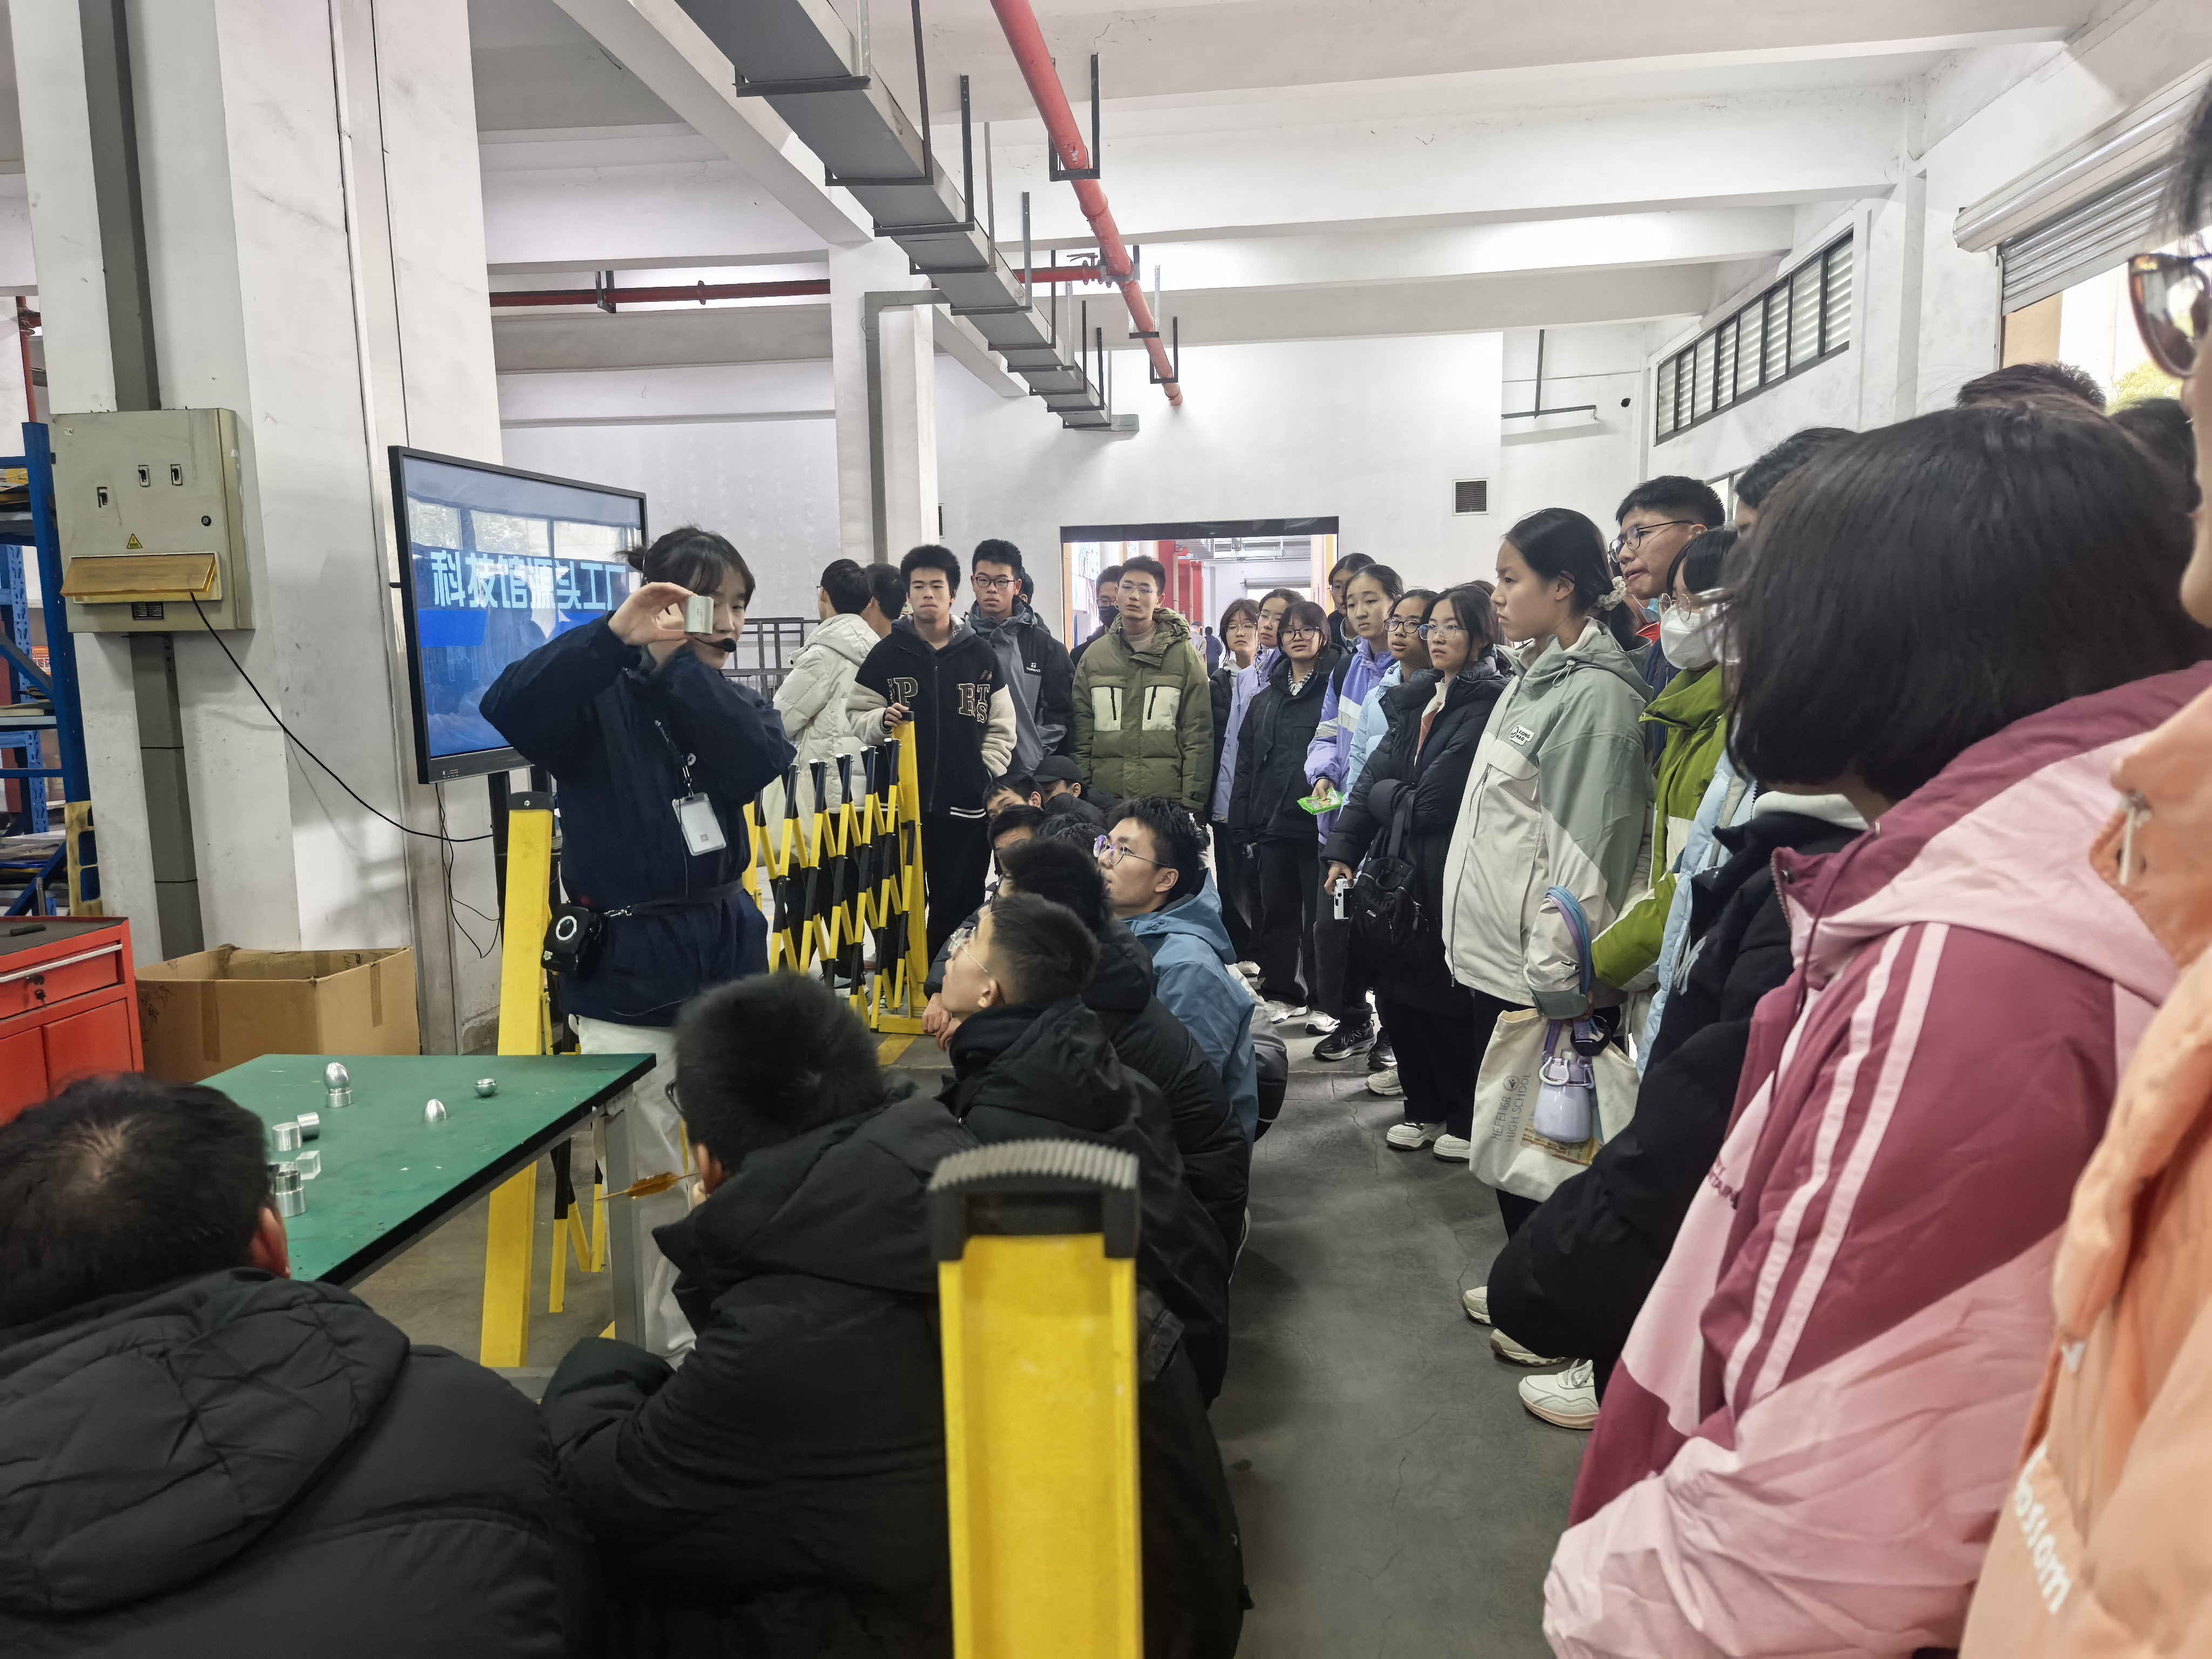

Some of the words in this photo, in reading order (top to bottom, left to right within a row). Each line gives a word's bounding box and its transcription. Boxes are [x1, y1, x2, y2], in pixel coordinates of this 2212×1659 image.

[430, 550, 626, 611] 科技馆源头工厂
[1512, 1073, 1532, 1114] SCHOOL
[1506, 1116, 1520, 1142] HIGH
